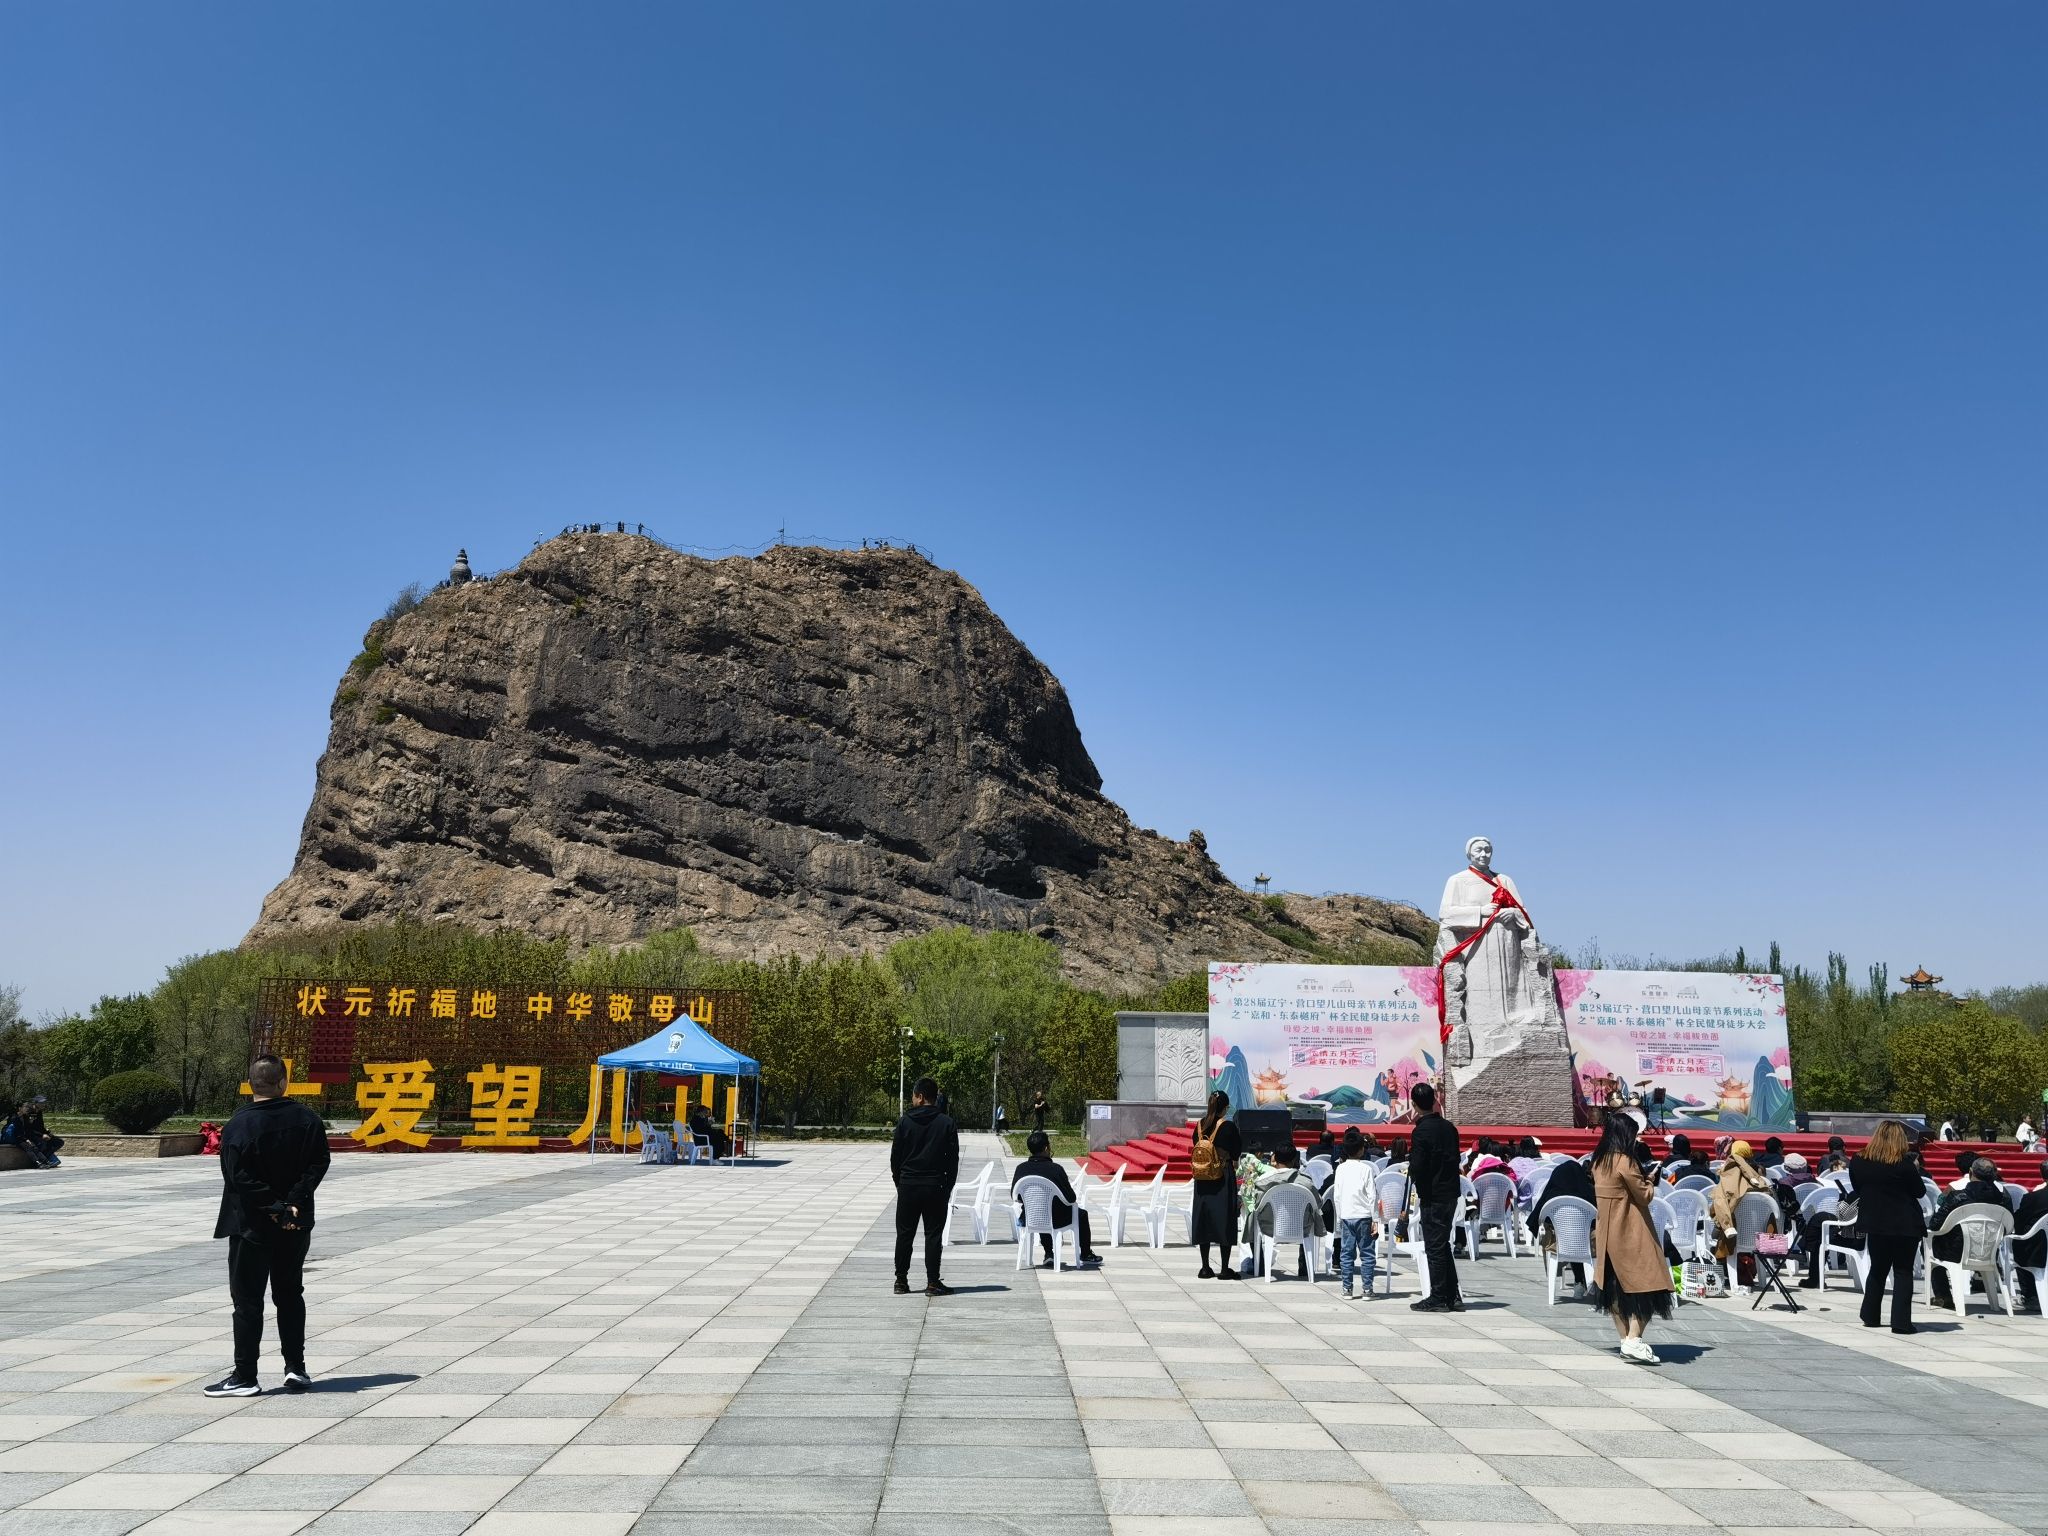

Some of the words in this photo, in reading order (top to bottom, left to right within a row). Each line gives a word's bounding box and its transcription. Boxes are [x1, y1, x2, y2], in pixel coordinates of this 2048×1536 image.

[297, 985, 498, 1018] 状元祈福地
[527, 991, 713, 1025] 中华敬母山
[1233, 997, 1417, 1010] 第28届辽宁·营口望儿山母亲节系列活动
[1579, 1003, 1763, 1017] 第28届辽宁·营口望儿山母亲节系列活动
